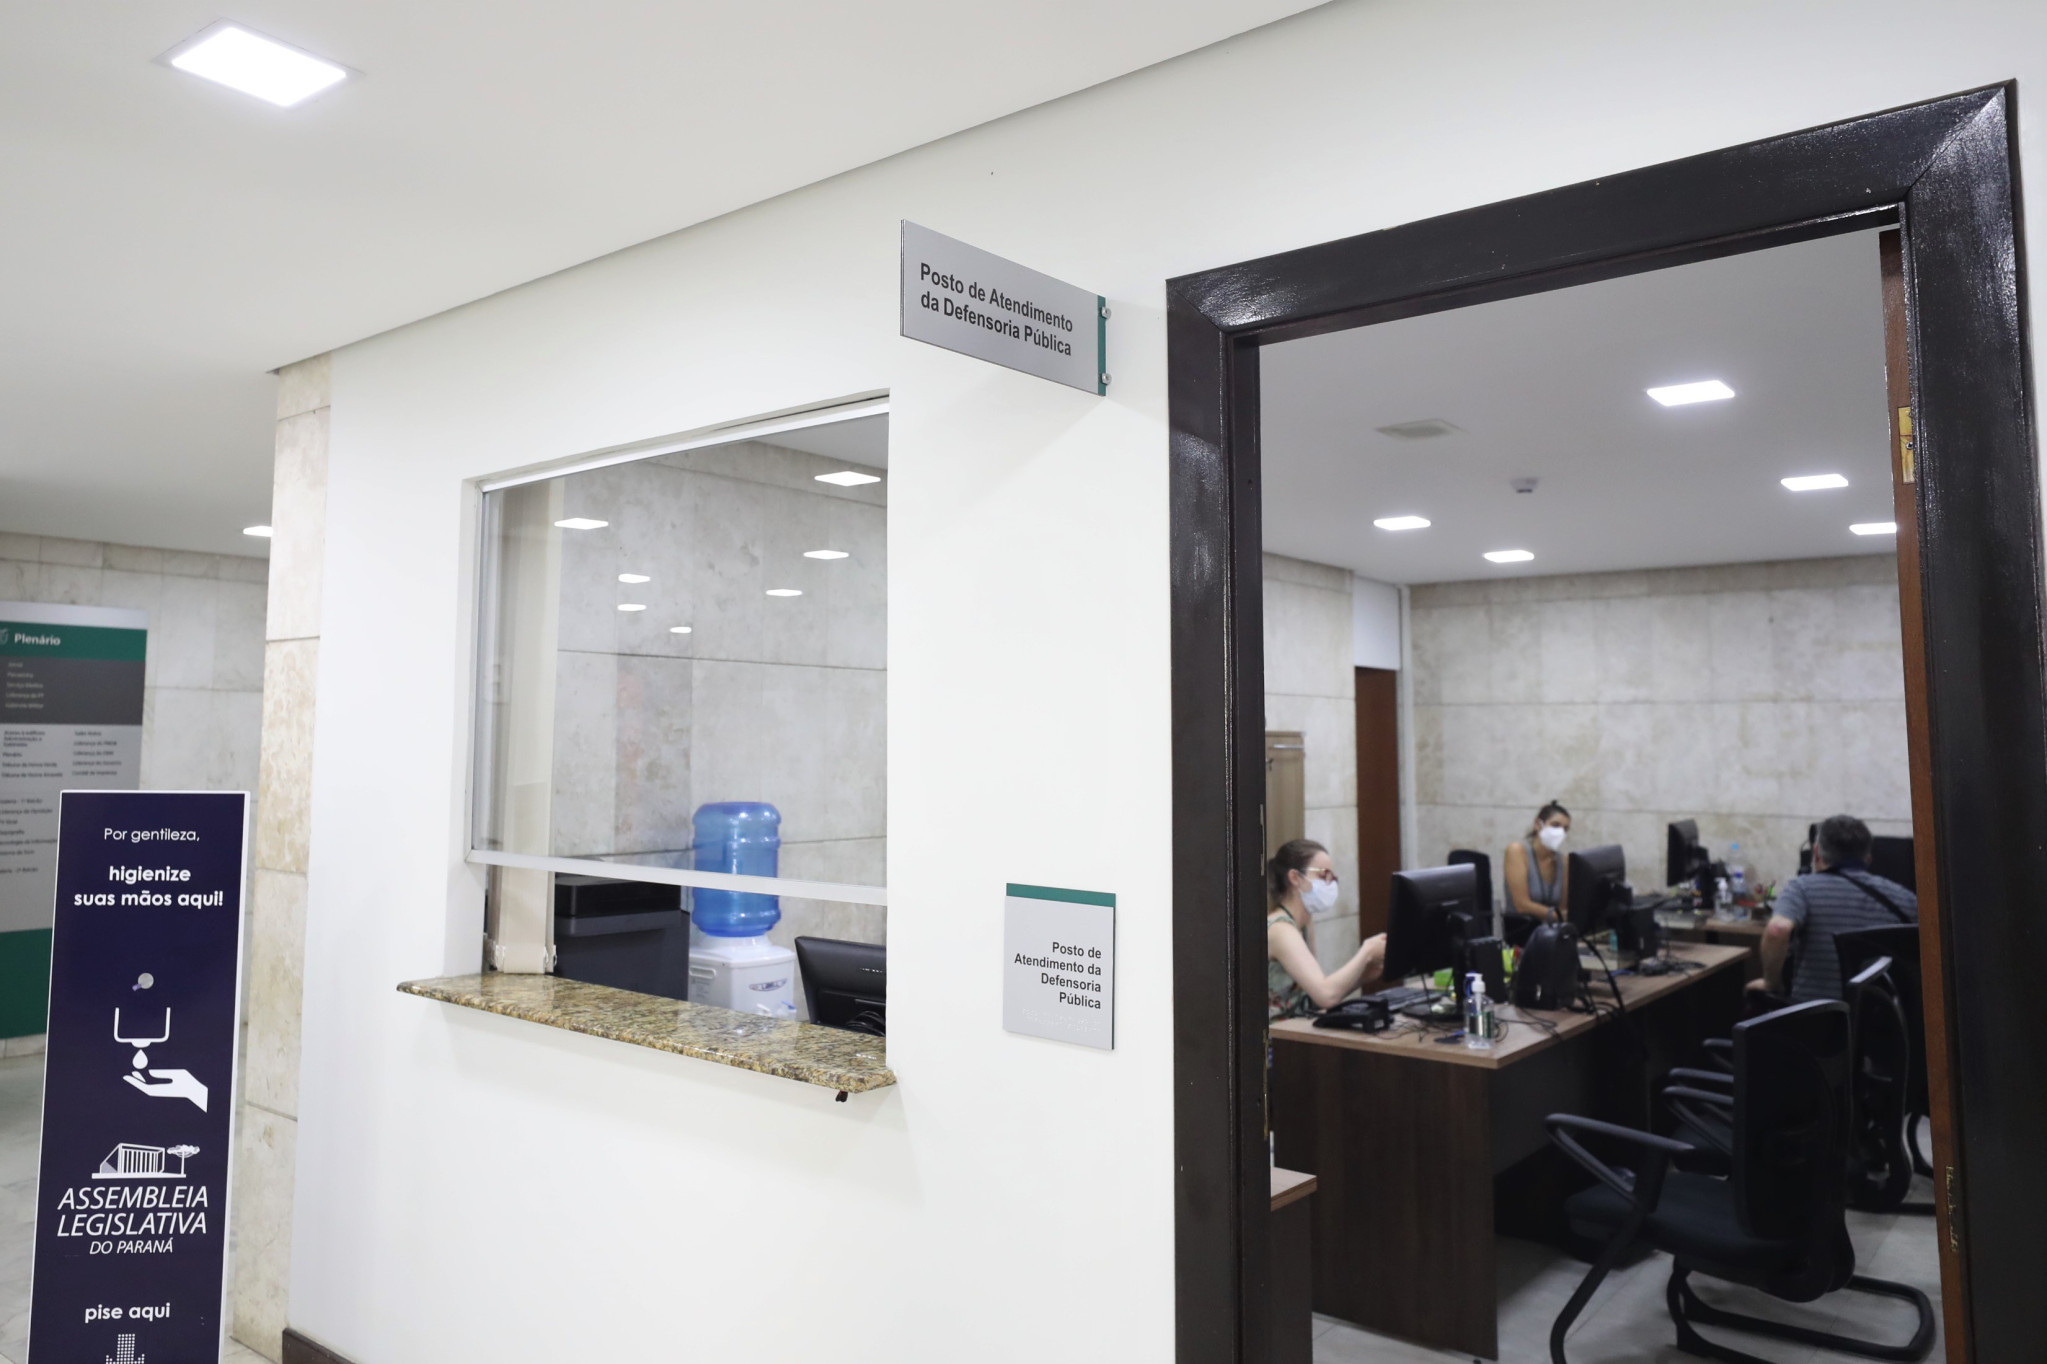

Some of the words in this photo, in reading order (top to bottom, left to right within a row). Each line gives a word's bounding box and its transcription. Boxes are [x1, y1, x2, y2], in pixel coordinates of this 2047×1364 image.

[920, 262, 964, 294] Posto
[969, 281, 986, 302] de
[989, 288, 1073, 332] Atendimento
[921, 291, 939, 312] da
[944, 297, 1020, 339] Defensoria
[1024, 325, 1072, 356] Pública
[14, 632, 61, 646] Plenário
[104, 827, 127, 840] Por
[131, 827, 200, 843] gentileza,
[109, 865, 191, 884] higienize
[74, 892, 115, 906] suas
[121, 889, 172, 906] mãos
[177, 890, 224, 909] aqui!
[1052, 942, 1084, 957] Posto
[1087, 946, 1102, 959] de
[1014, 953, 1084, 973] Atendimento
[1087, 963, 1102, 976] da
[1041, 972, 1101, 993] Defensoria
[1059, 992, 1101, 1009] Pública
[57, 1185, 208, 1210] ASSEMBLEIA
[57, 1212, 207, 1237] LEGISLATIVA
[90, 1240, 113, 1255] DO
[116, 1237, 173, 1254] PARANÁ
[85, 1304, 123, 1323] pise
[128, 1302, 171, 1322] aqui
